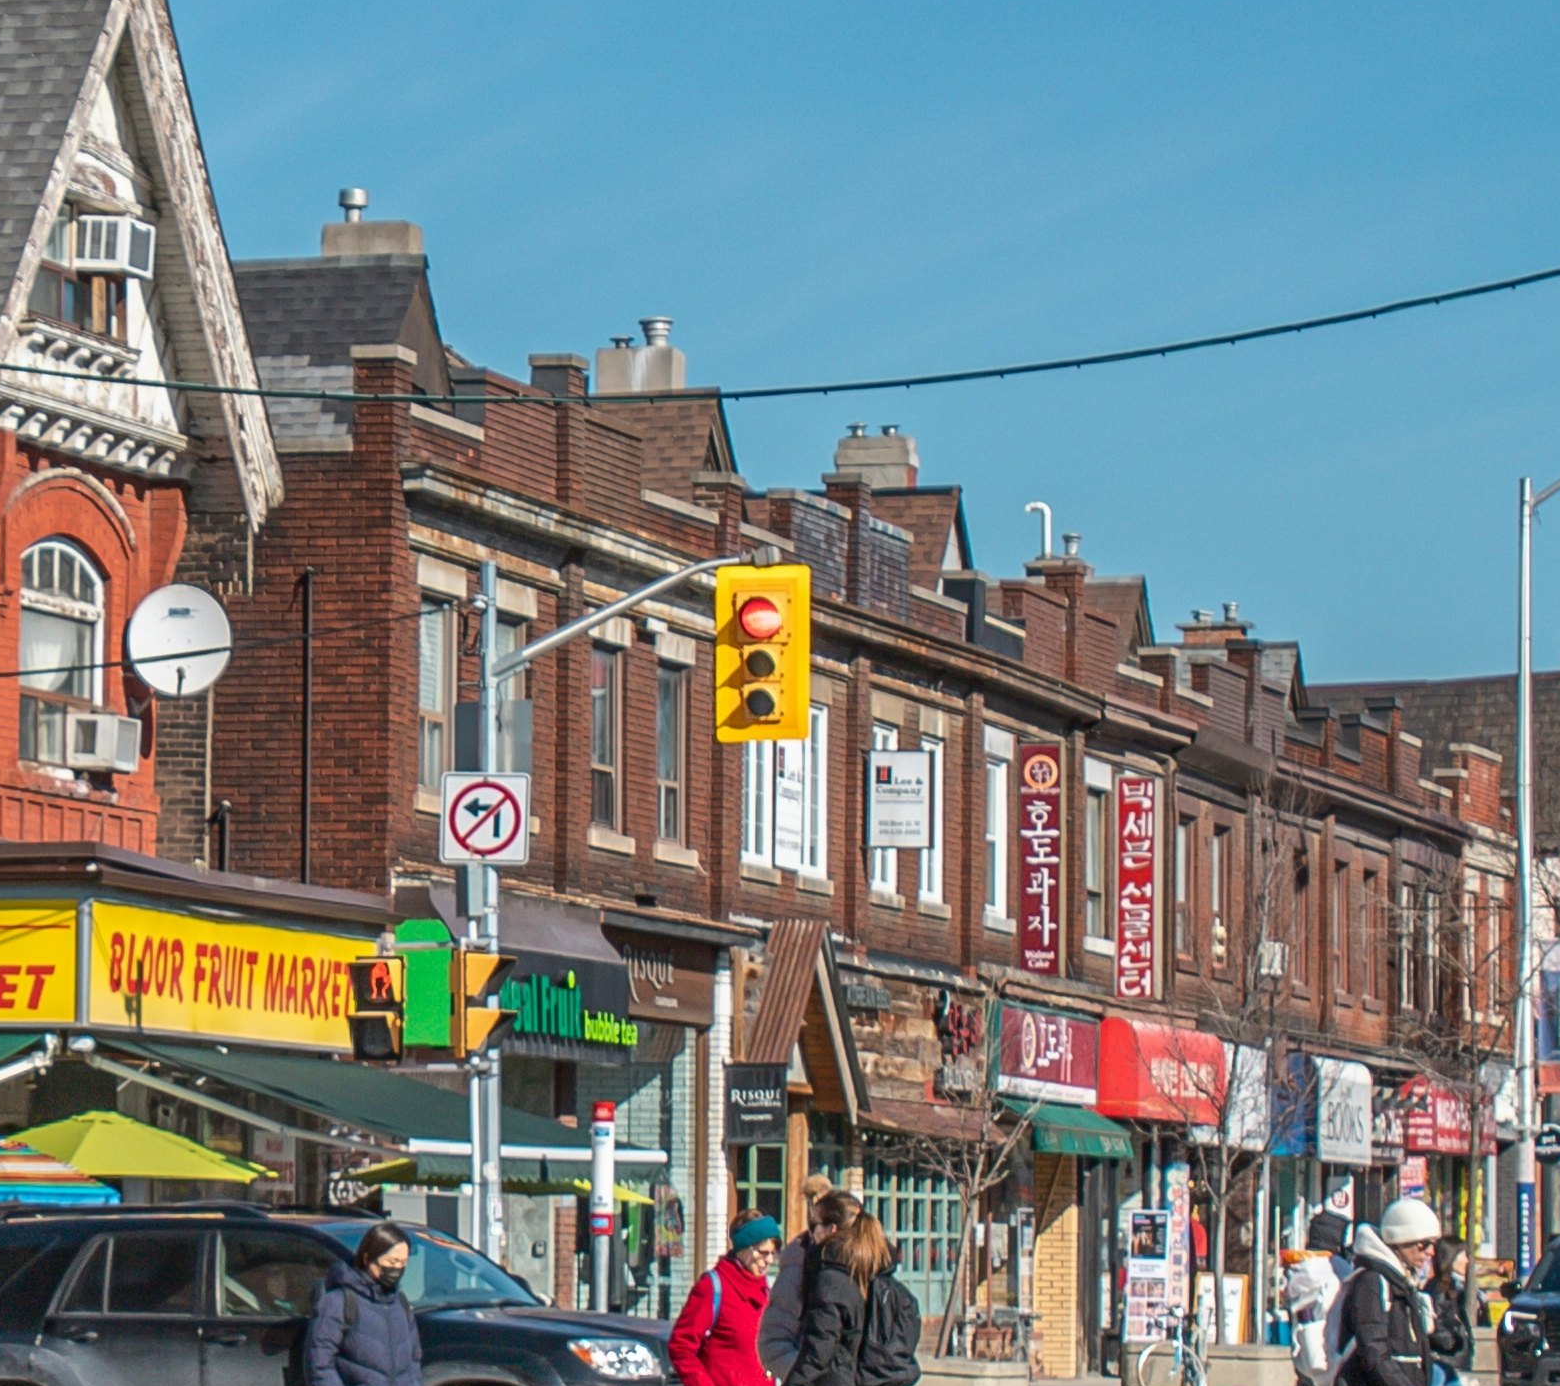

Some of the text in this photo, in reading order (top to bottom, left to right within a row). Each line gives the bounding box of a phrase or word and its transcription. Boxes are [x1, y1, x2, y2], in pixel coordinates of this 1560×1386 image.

[875, 787, 922, 795] Company
[894, 777, 913, 785] Lee
[1020, 800, 1060, 946] 호도과자
[1024, 948, 1056, 960] Walnut
[1027, 959, 1051, 969] Cake
[109, 932, 353, 1018] BLOOR FRUIT MARKET
[541, 969, 583, 1039] Fruit
[584, 1010, 638, 1046] bubble tea
[1326, 1101, 1364, 1144] BOOKS
